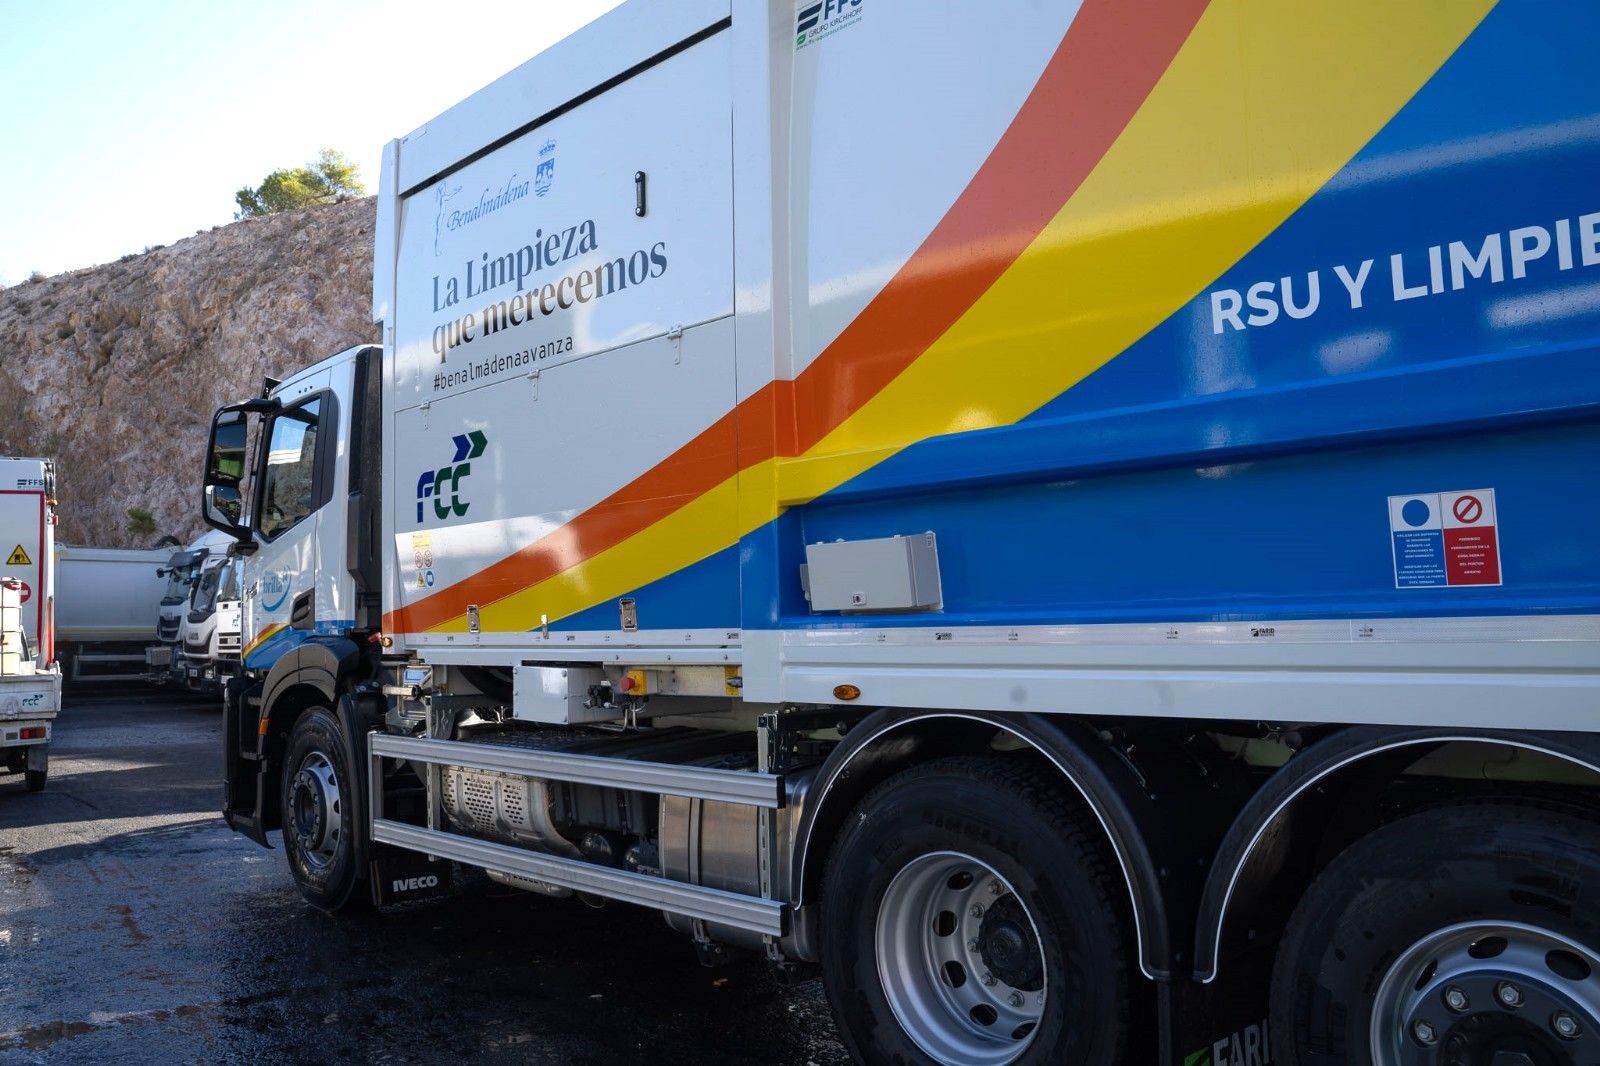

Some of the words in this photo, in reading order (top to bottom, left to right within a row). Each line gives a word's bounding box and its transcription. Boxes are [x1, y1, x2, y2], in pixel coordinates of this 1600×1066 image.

[808, 23, 828, 38] GRUPO
[830, 6, 863, 27] KIRCHHOFF
[447, 174, 529, 231] Benalmádena
[432, 275, 459, 313] La
[465, 219, 599, 299] Limpieza
[432, 306, 475, 364] que
[482, 241, 668, 337] merecemos
[1210, 270, 1321, 335] RSU
[1333, 259, 1375, 309] Y
[433, 334, 574, 391] #benalmádenaavanza
[417, 462, 471, 523] FCC
[393, 875, 438, 893] IVECO
